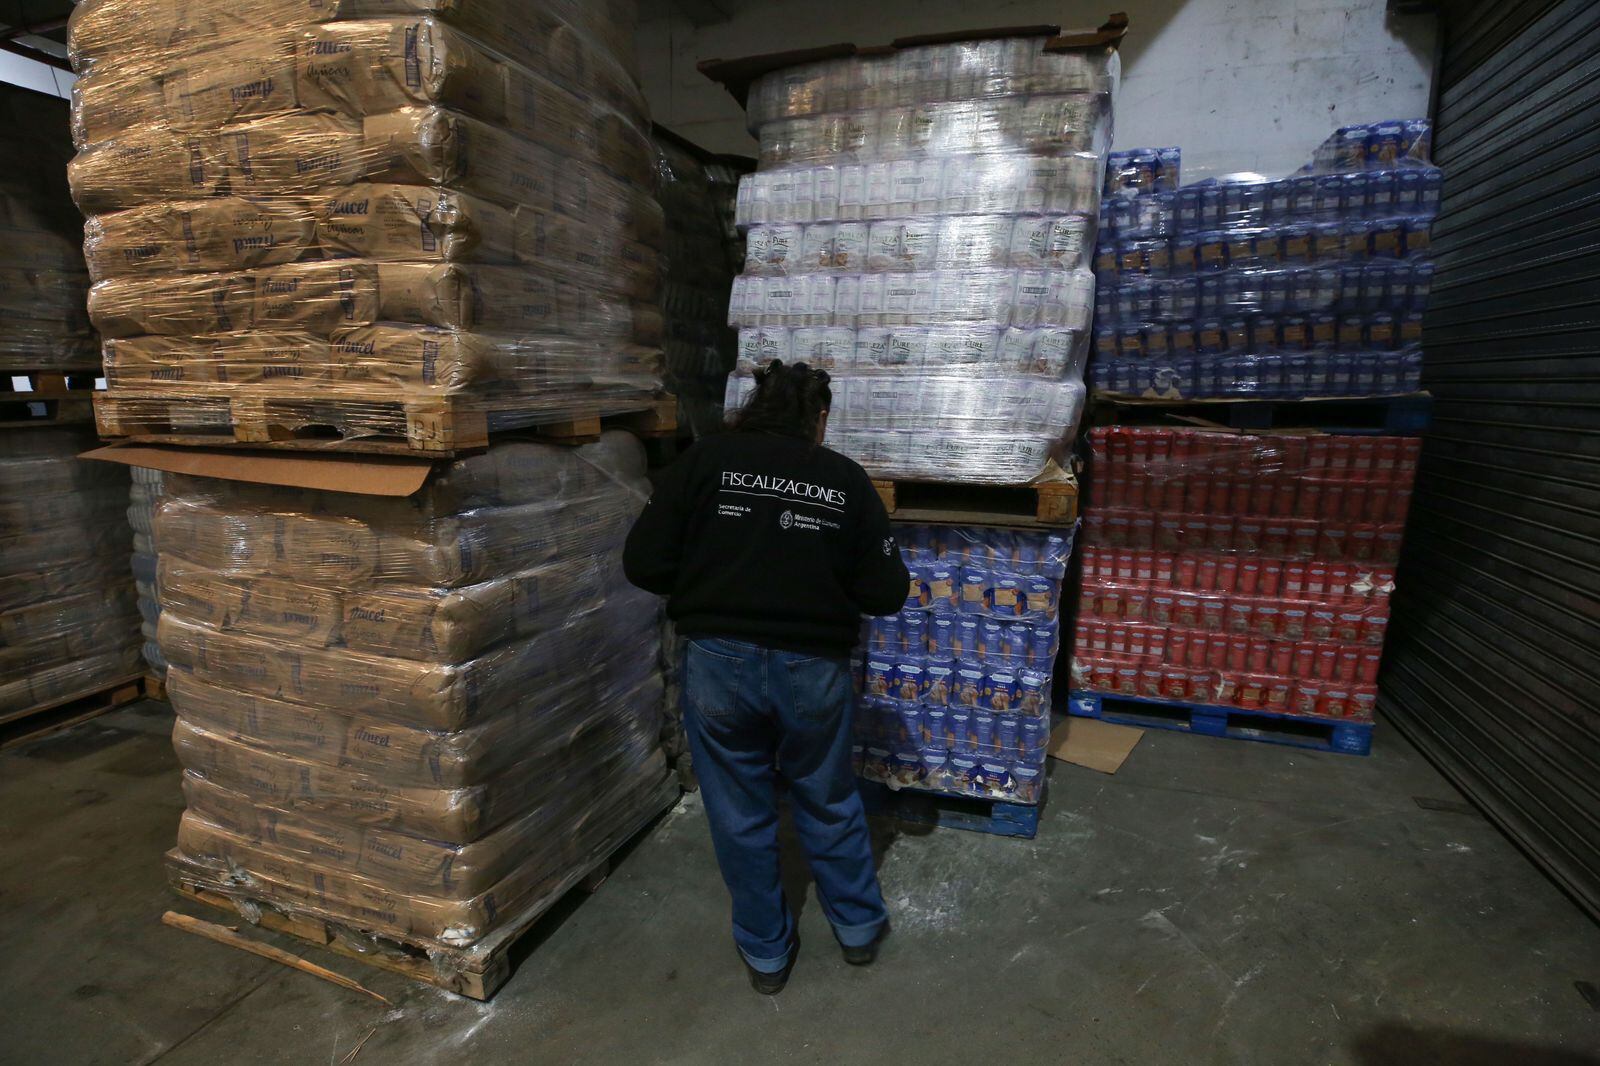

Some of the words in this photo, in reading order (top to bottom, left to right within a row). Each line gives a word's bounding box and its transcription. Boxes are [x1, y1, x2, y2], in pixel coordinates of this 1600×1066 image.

[722, 471, 846, 505] FISCALIZACIONES
[718, 509, 742, 517] Comercio
[794, 521, 820, 531] Argentina
